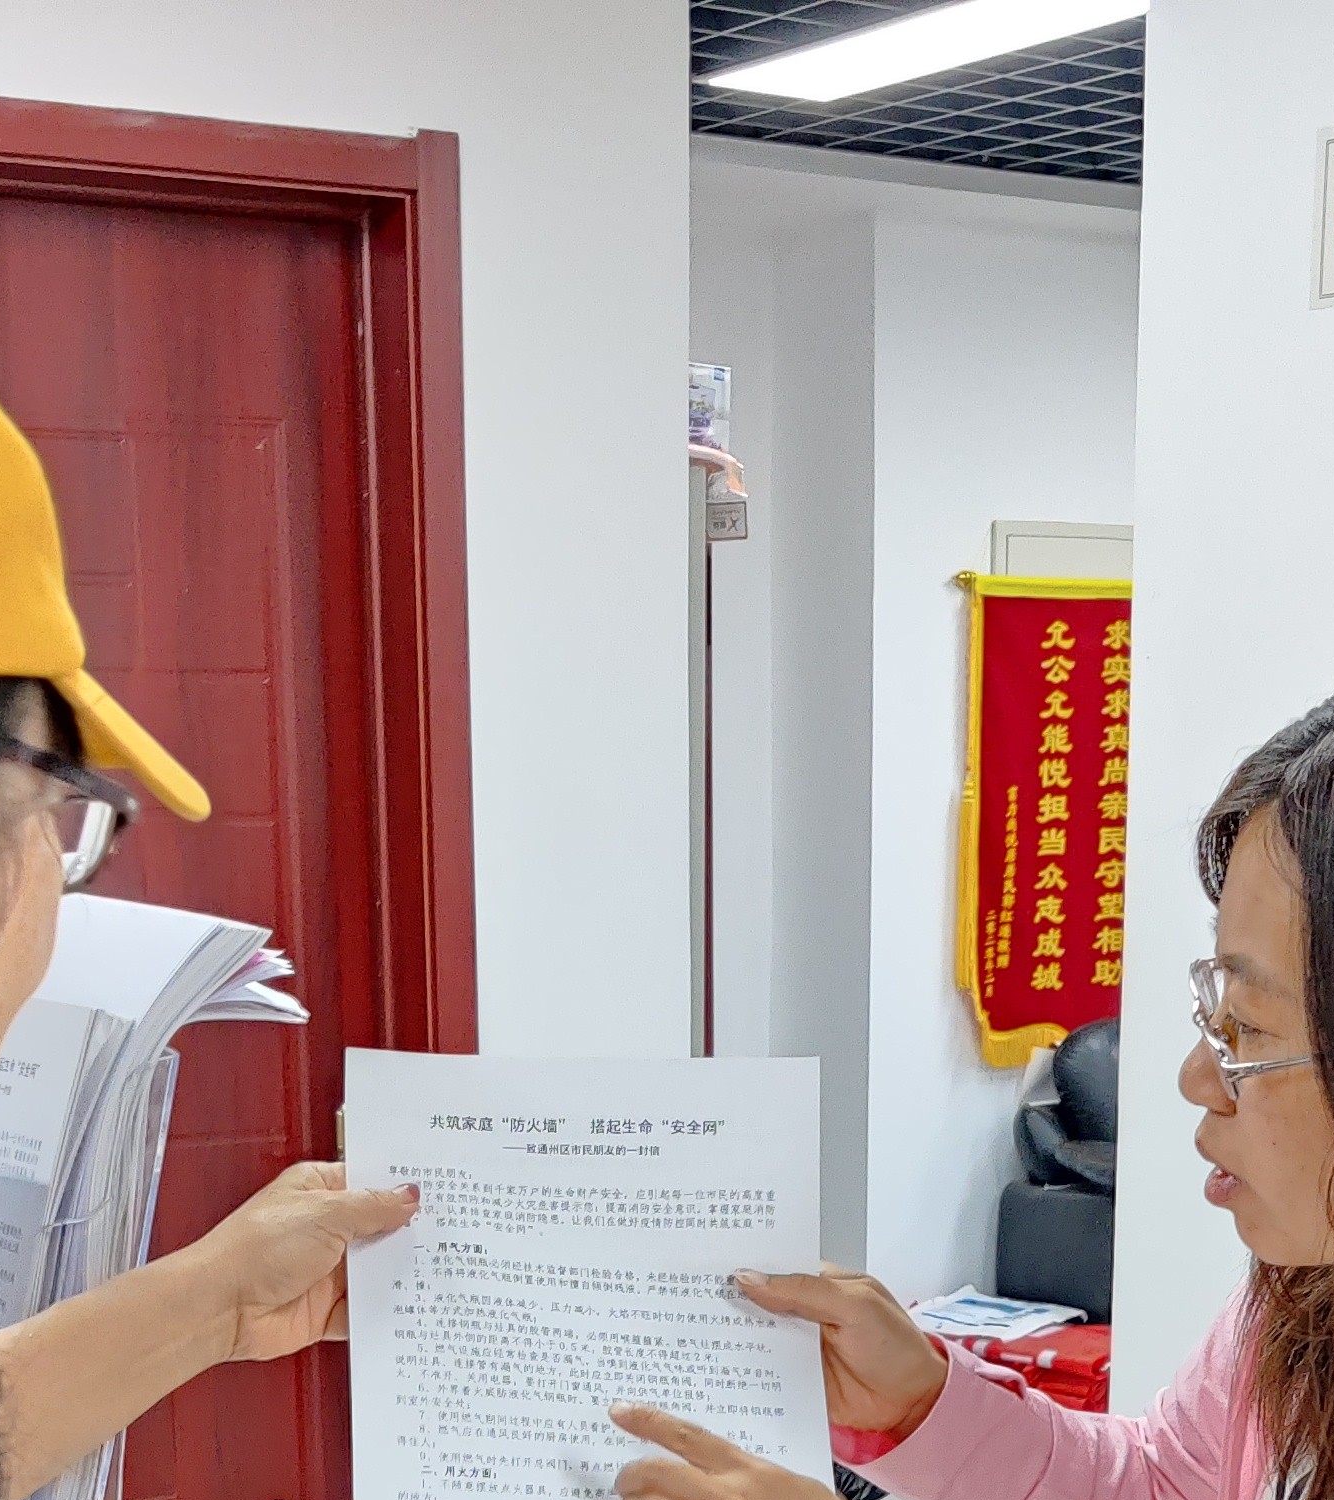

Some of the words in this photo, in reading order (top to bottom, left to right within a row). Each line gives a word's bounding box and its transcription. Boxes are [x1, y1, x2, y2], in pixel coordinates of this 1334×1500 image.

[1031, 619, 1076, 991] 允公允能悦担当众志成城
[1091, 619, 1131, 987] 求实求真尚亲民守望相助
[430, 1115, 566, 1133] 共筑家庭“防火墙”
[590, 1118, 725, 1136] 搭起生命“安全网”
